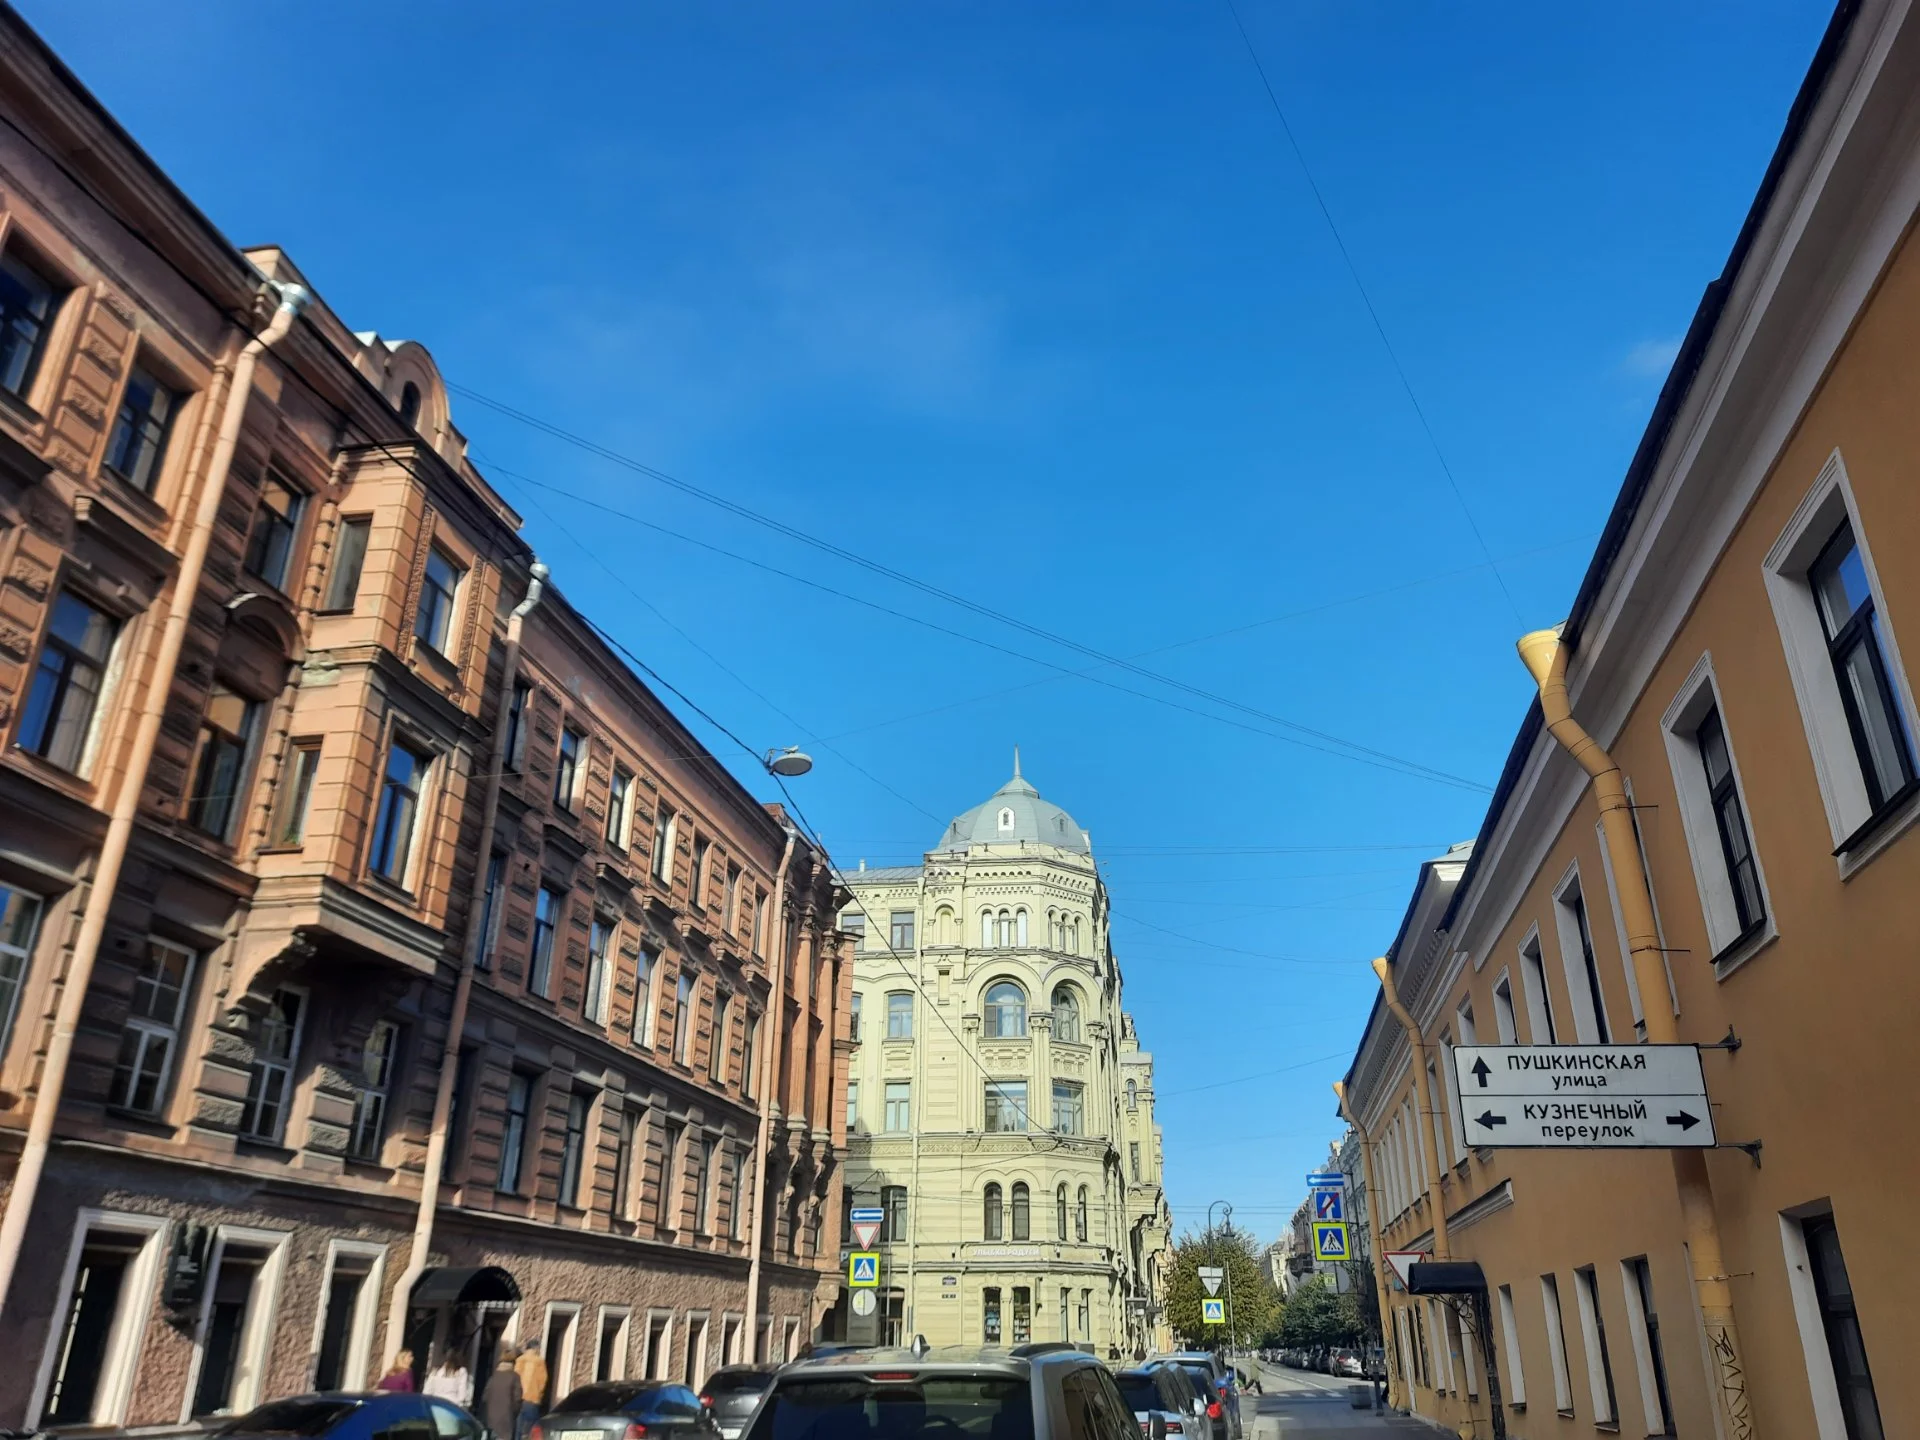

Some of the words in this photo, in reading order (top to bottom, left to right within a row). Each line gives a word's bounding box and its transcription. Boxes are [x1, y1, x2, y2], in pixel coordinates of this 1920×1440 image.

[1507, 1054, 1646, 1070] ПУШКИНСКАЯ
[1552, 1075, 1608, 1090] улица
[1523, 1099, 1647, 1120] КУЗНЕЧНЫЙ
[1541, 1125, 1635, 1141] переулок
